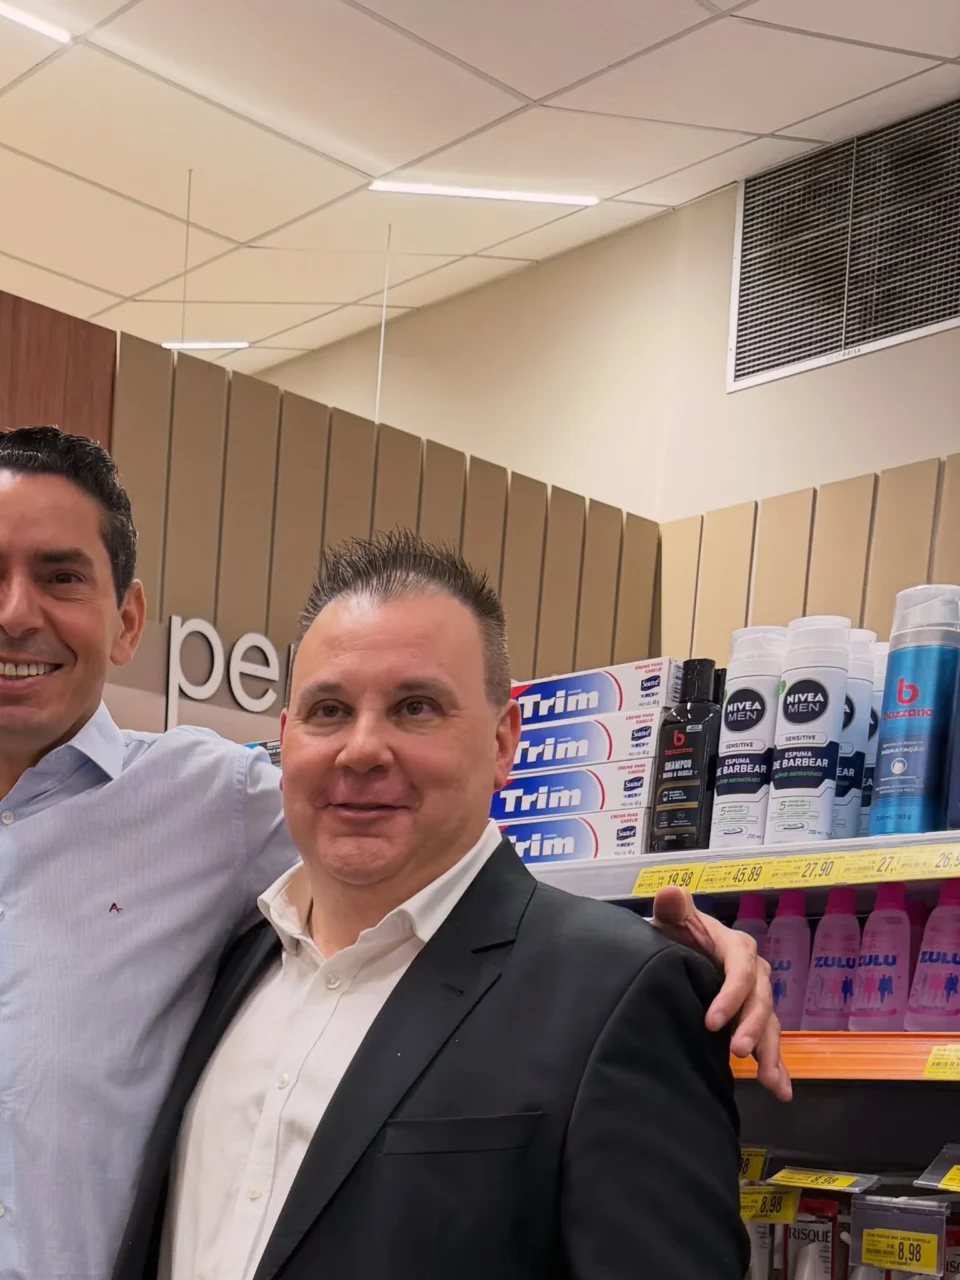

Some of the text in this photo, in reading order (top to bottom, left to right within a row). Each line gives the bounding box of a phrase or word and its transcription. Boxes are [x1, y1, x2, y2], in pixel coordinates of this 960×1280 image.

[897, 678, 920, 706] b
[518, 690, 600, 719] Trim
[786, 693, 825, 705] NIVEA
[726, 701, 762, 713] NIVEA
[787, 703, 820, 714] MEN
[727, 711, 757, 722] MEN
[673, 730, 685, 746] b
[785, 734, 816, 742] SENSITIVE
[725, 741, 754, 750] SENSITIVE
[664, 760, 692, 771] SHAMPOO
[725, 757, 751, 765] ESPUMA
[782, 758, 828, 769] BARBEAR
[723, 764, 767, 774] BARBEAR
[500, 786, 582, 813] Trim
[732, 866, 763, 885] 45,89
[801, 861, 834, 878] 27,90
[814, 956, 856, 969] ZULU
[858, 954, 897, 967] ZULU
[760, 1196, 783, 1214] 8,98
[898, 1242, 922, 1264] 8,98
